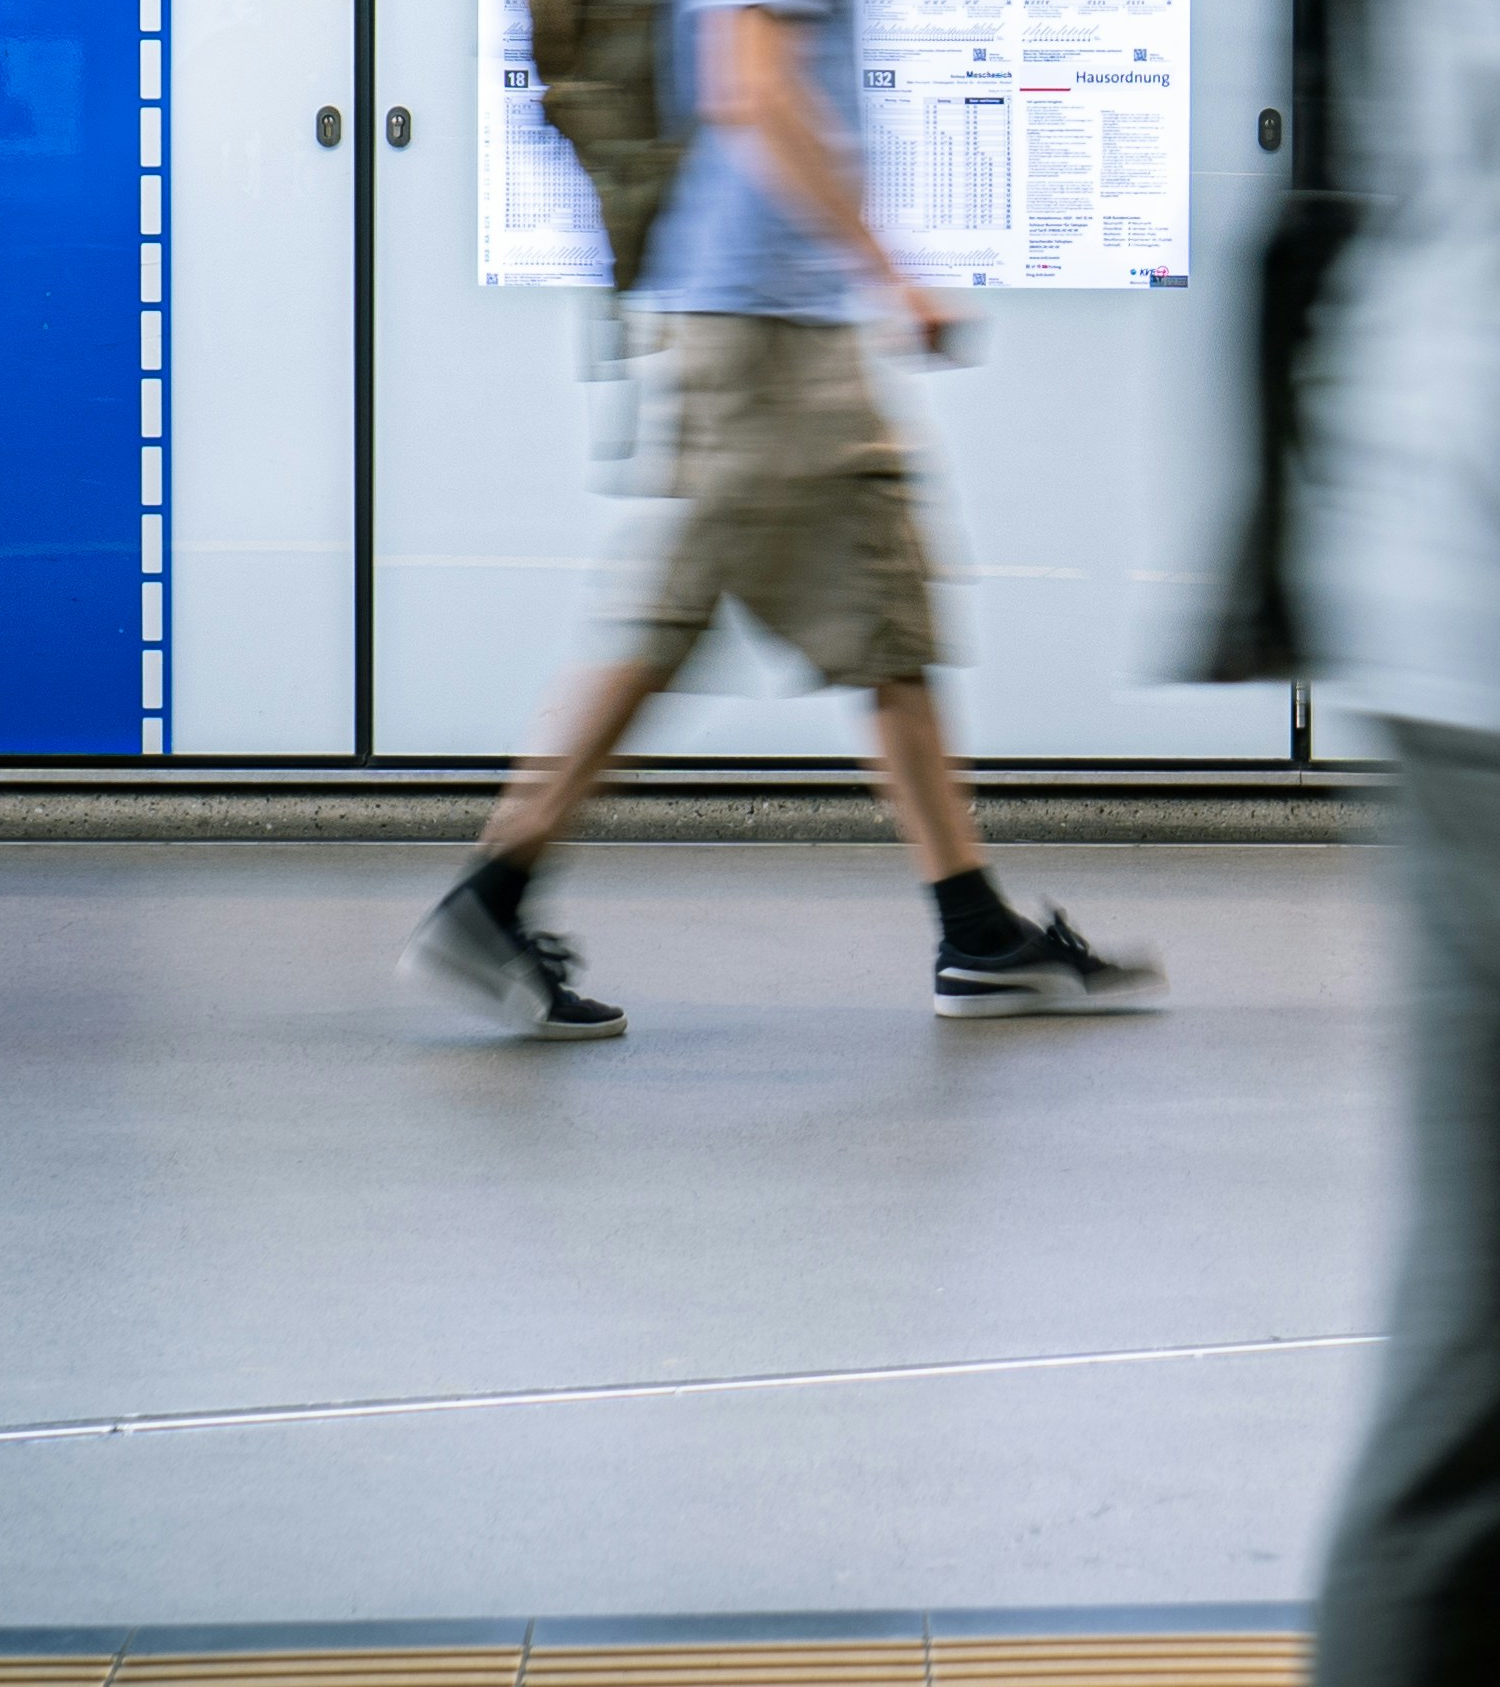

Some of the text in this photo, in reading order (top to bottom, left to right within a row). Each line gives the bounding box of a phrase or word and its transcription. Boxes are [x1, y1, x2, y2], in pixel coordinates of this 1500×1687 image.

[508, 72, 526, 87] 18
[867, 71, 893, 87] 132
[1075, 70, 1170, 87] Hausordnung
